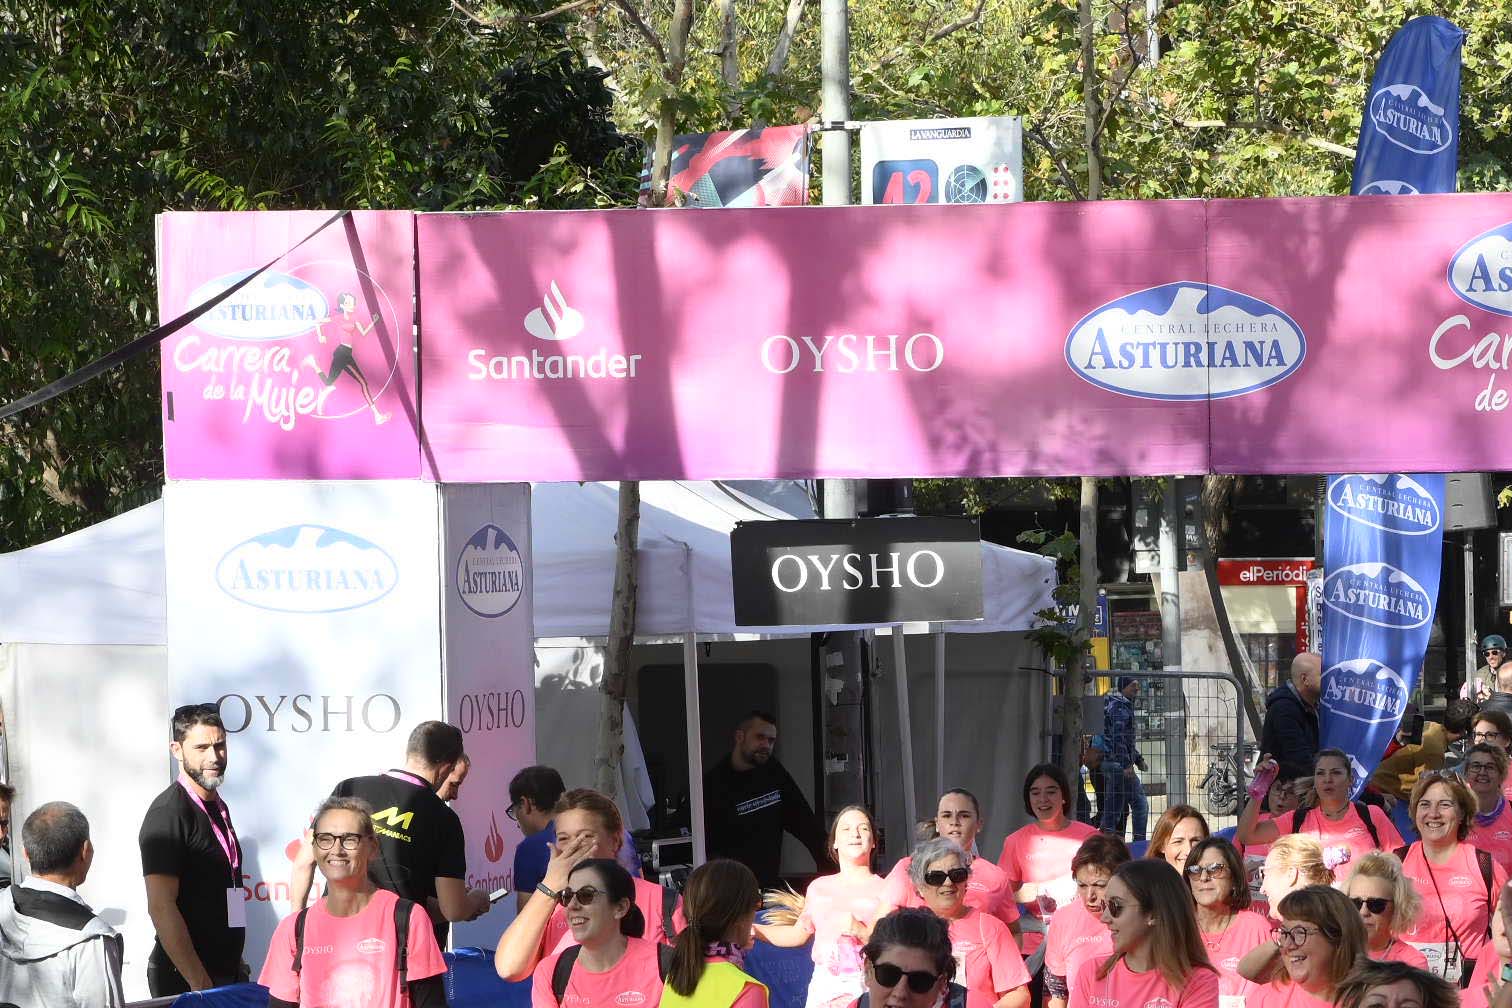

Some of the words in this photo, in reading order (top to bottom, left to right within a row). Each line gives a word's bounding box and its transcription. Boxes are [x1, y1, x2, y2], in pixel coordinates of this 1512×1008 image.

[911, 129, 922, 141] LA
[922, 127, 970, 140] VANGUARDIA
[1083, 327, 1287, 370] ASTURIANA
[1120, 322, 1195, 336] CENTRAL
[1203, 321, 1279, 335] LECHERA
[174, 335, 291, 372] Carrera
[467, 348, 642, 381] Santander
[760, 333, 944, 374] OYSHO
[203, 377, 225, 400] de
[230, 377, 245, 400] la
[243, 369, 336, 431] Mujer
[1474, 371, 1509, 413] de
[1337, 485, 1433, 527] ASTURIANA
[232, 559, 385, 591] ASTURIANA
[461, 559, 520, 595] ASTURIANA
[771, 550, 944, 593] OYSHO
[1240, 565, 1306, 582] elPeriódi
[1330, 577, 1423, 620] ASTURIANA
[216, 694, 402, 733] OYSHO
[459, 689, 525, 734] OYSHO
